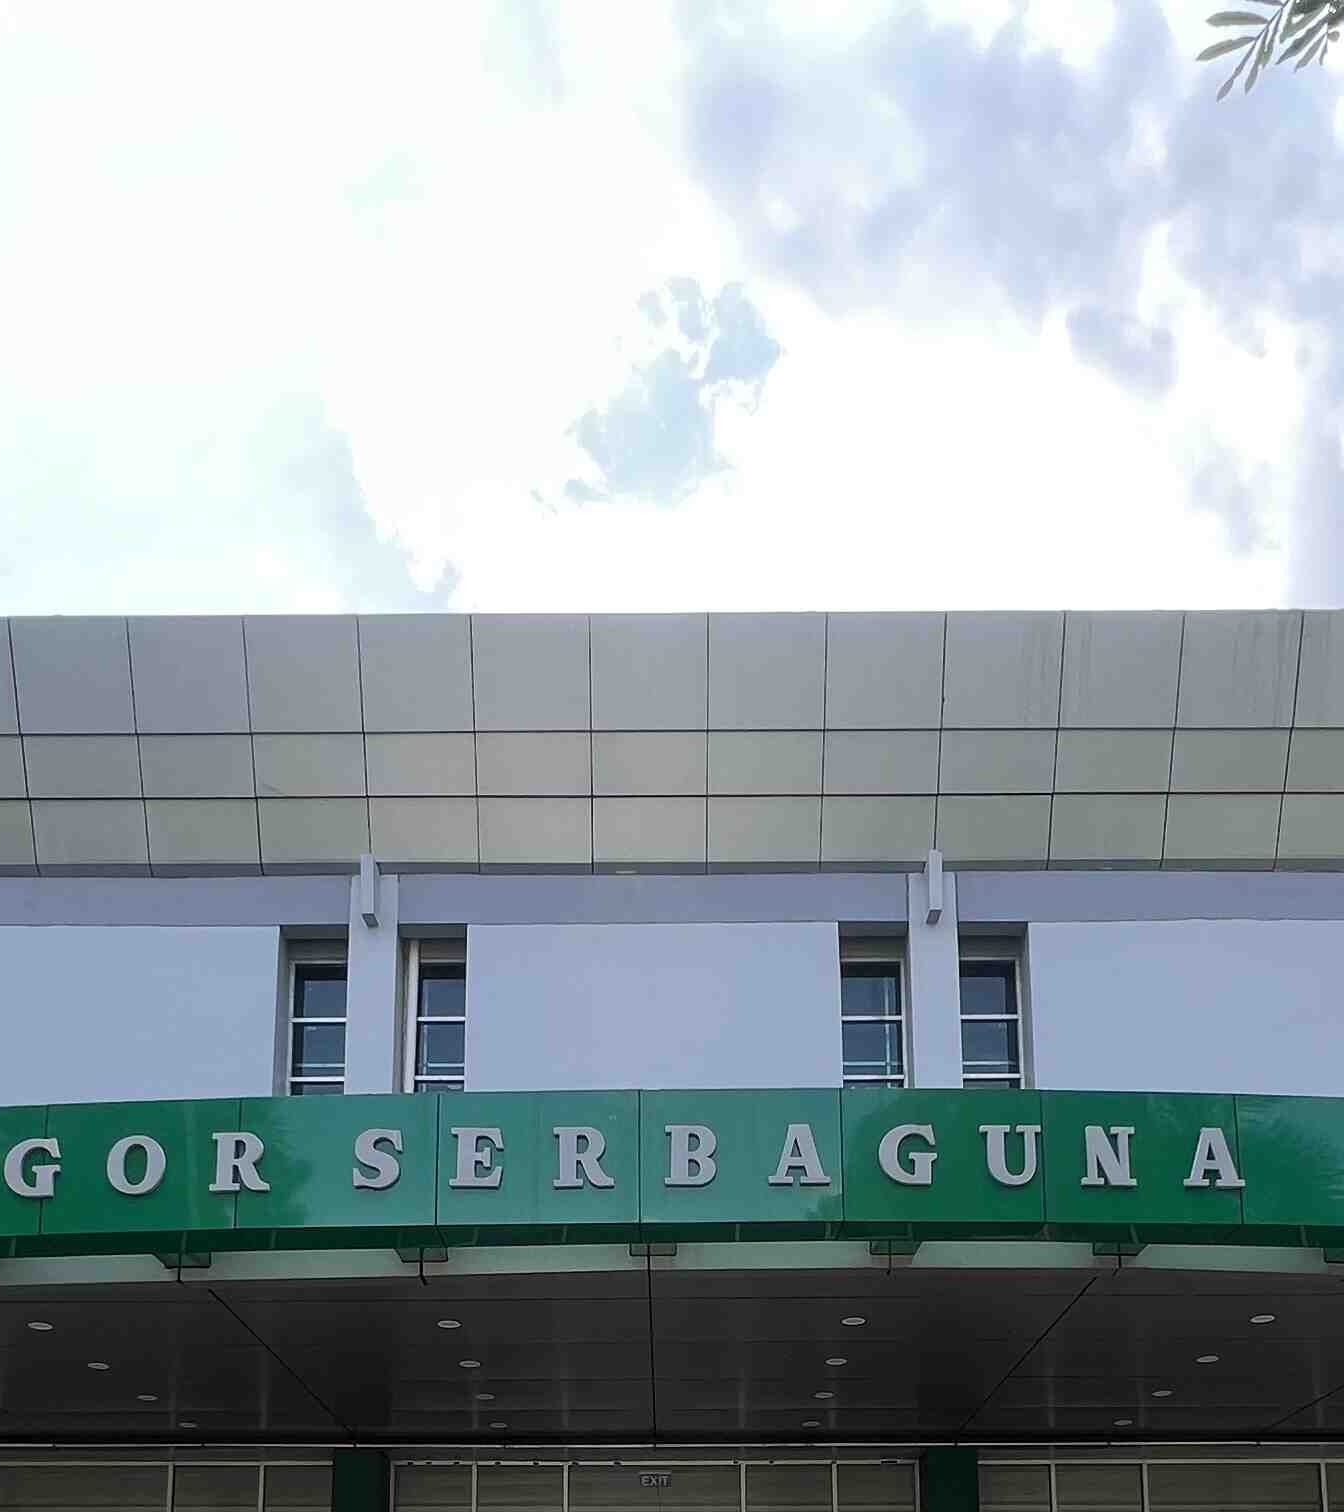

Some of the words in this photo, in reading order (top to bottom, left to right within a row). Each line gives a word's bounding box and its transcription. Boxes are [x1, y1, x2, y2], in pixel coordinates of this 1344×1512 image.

[4, 1132, 270, 1197] GOR
[352, 1123, 1246, 1189] SERBAGUNA
[641, 1475, 669, 1487] EXIT
